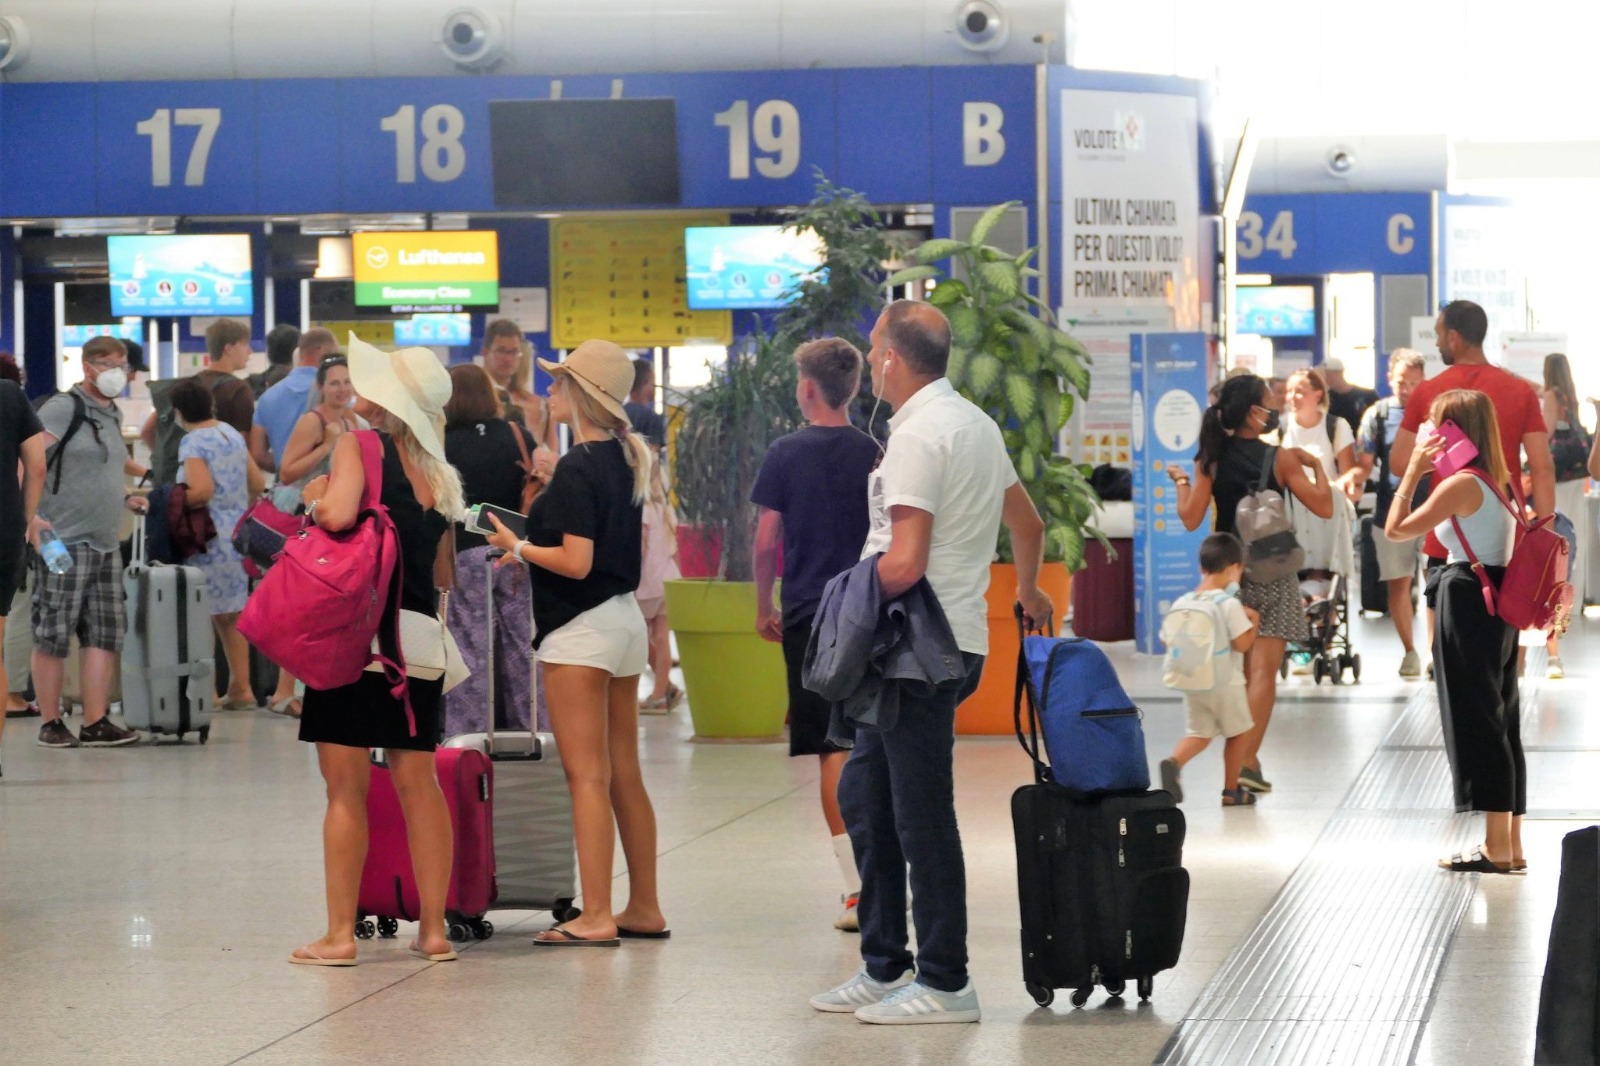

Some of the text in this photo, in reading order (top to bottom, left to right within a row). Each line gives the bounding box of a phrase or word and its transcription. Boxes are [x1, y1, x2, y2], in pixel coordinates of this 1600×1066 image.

[136, 108, 221, 187] 17
[380, 103, 466, 183] 18
[714, 99, 800, 180] 19
[963, 101, 1006, 167] B
[1074, 198, 1177, 226] ULTIMA CHIAMATA
[1236, 210, 1297, 259] 34
[1387, 213, 1415, 255] C
[398, 249, 485, 265] Lufthansa
[1074, 234, 1102, 262] PER
[1106, 235, 1152, 262] QUESTO
[1074, 271, 1118, 298] PRIMA
